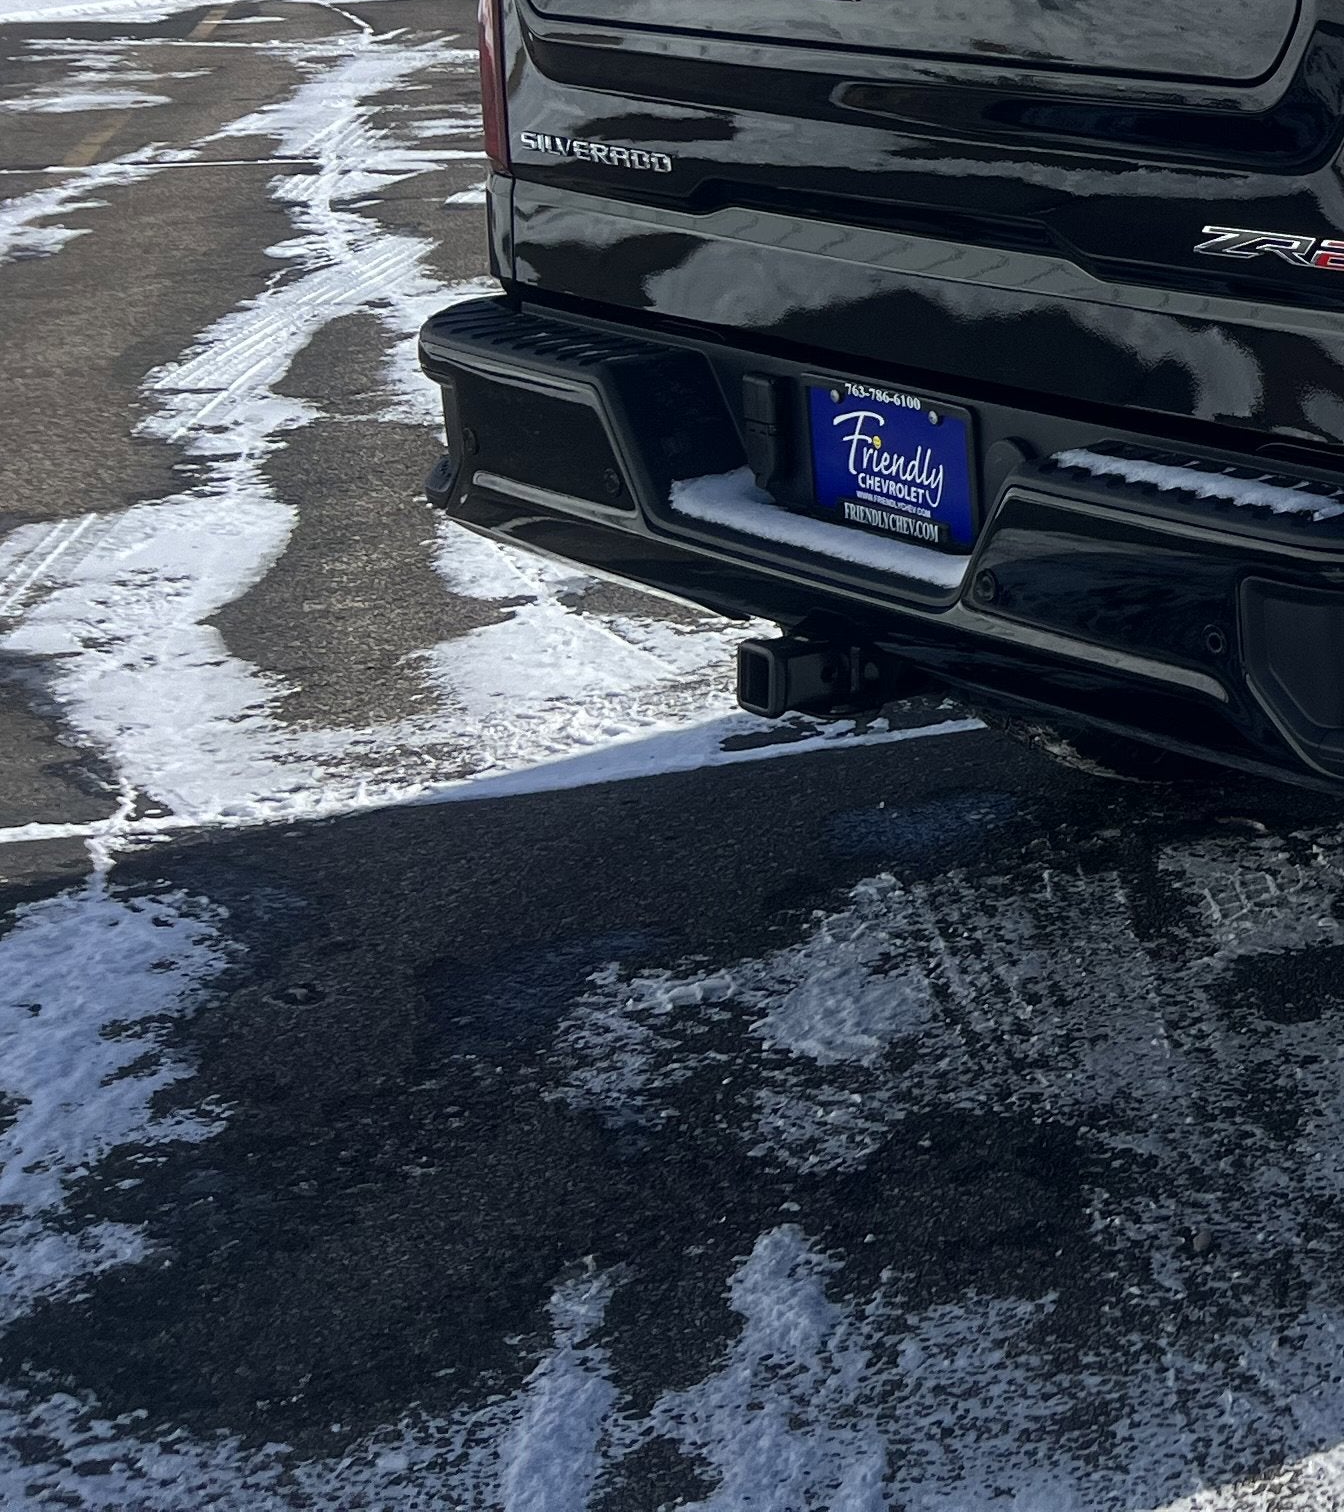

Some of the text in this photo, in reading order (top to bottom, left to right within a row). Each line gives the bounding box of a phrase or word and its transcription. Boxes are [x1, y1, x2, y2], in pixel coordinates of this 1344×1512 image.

[521, 131, 673, 173] SILVERADO
[845, 383, 921, 411] 763-786-6100
[833, 411, 943, 508] Friendly
[858, 473, 924, 503] CHEVROLET
[844, 502, 939, 543] FRIENDLYCHEV.COM
